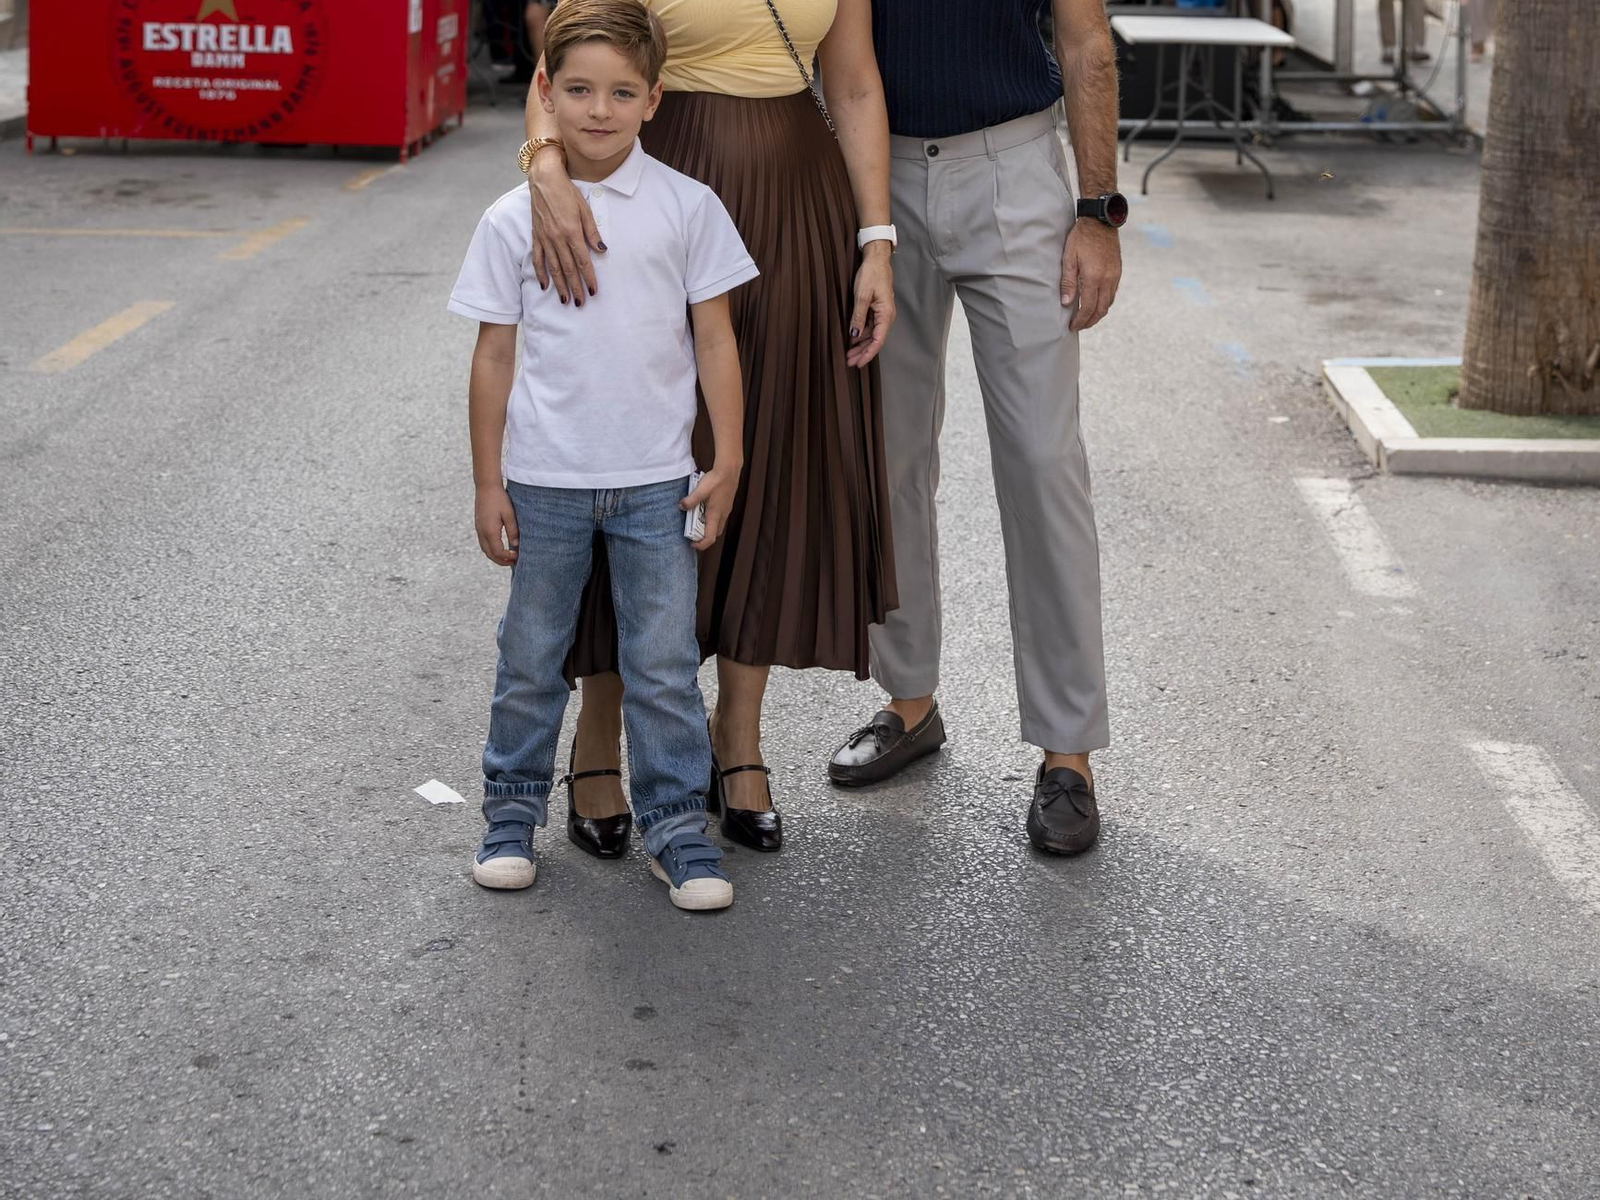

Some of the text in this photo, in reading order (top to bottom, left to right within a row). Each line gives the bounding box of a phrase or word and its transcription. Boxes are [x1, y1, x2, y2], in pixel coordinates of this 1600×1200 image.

[142, 21, 294, 54] ESTRELLA
[191, 52, 246, 69] DAMM
[152, 76, 282, 92] RECETA ORIGINAL
